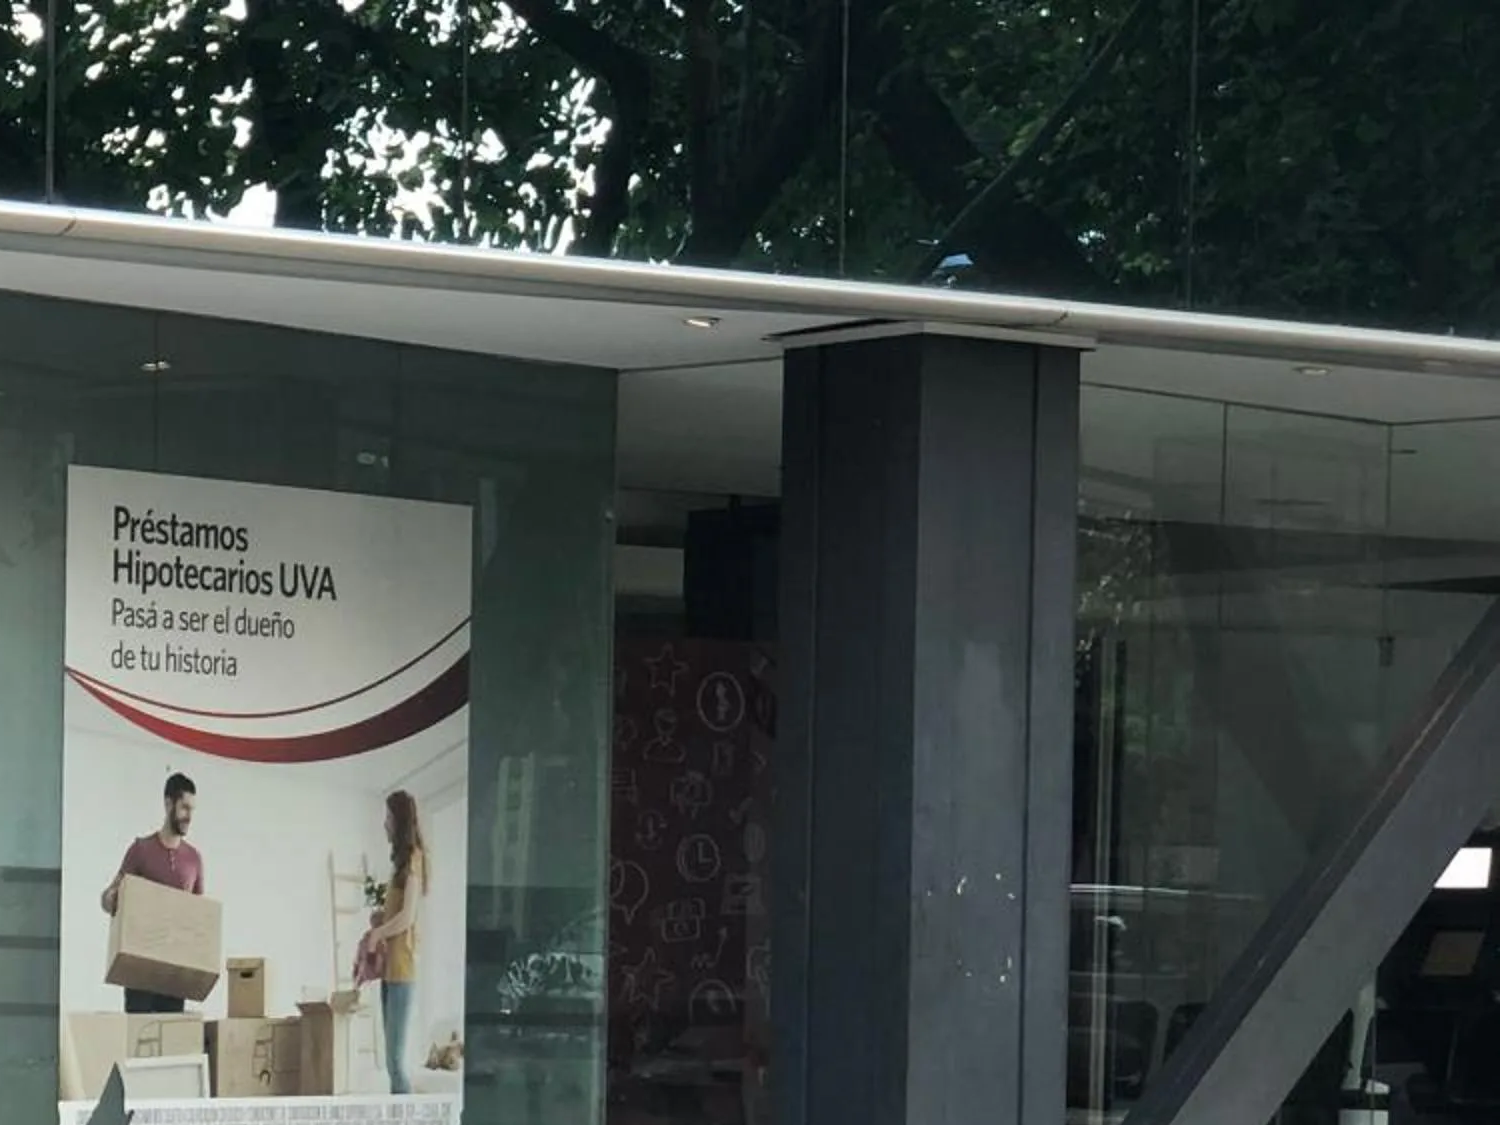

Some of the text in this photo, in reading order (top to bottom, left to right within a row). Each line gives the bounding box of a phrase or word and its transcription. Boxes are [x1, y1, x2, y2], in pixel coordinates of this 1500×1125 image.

[113, 505, 248, 552] Préstamos
[113, 548, 337, 601] Hipotecarios UVA
[112, 598, 295, 640] Pasá a ser el dueño
[111, 641, 238, 677] de tu historia
